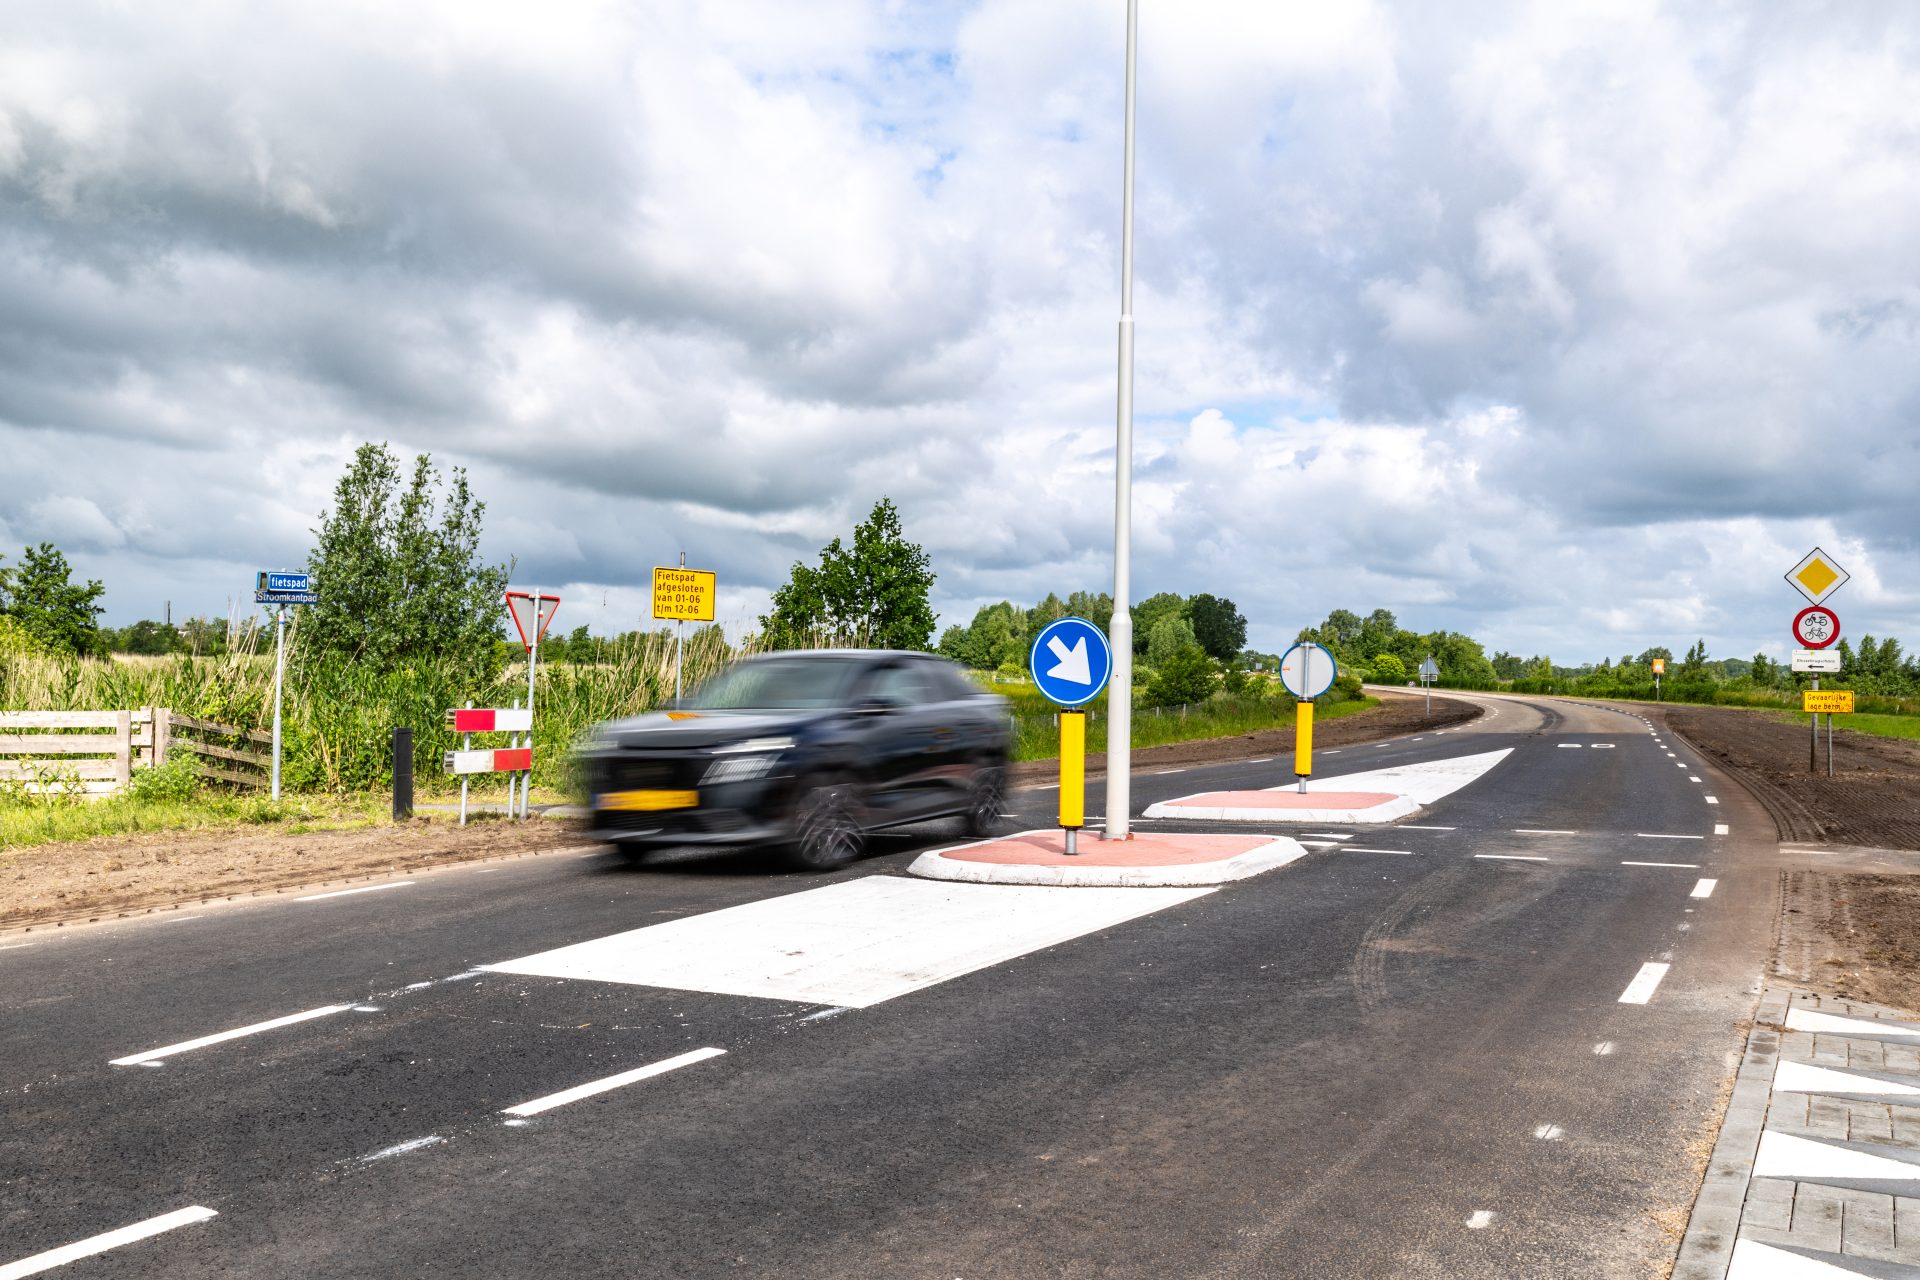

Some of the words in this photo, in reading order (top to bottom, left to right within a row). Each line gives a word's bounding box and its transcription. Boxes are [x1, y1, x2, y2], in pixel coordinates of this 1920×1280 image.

[657, 571, 695, 583] Fietspad
[271, 577, 306, 589] fietspad
[657, 582, 705, 594] afgesloten
[257, 592, 317, 603] Stroomkantpad
[657, 594, 673, 602] van
[675, 593, 701, 604] 01-06
[657, 604, 672, 615] t/m
[675, 604, 699, 614] 12-06
[1807, 693, 1847, 703] Gevaarlijke
[1807, 702, 1822, 711] lage
